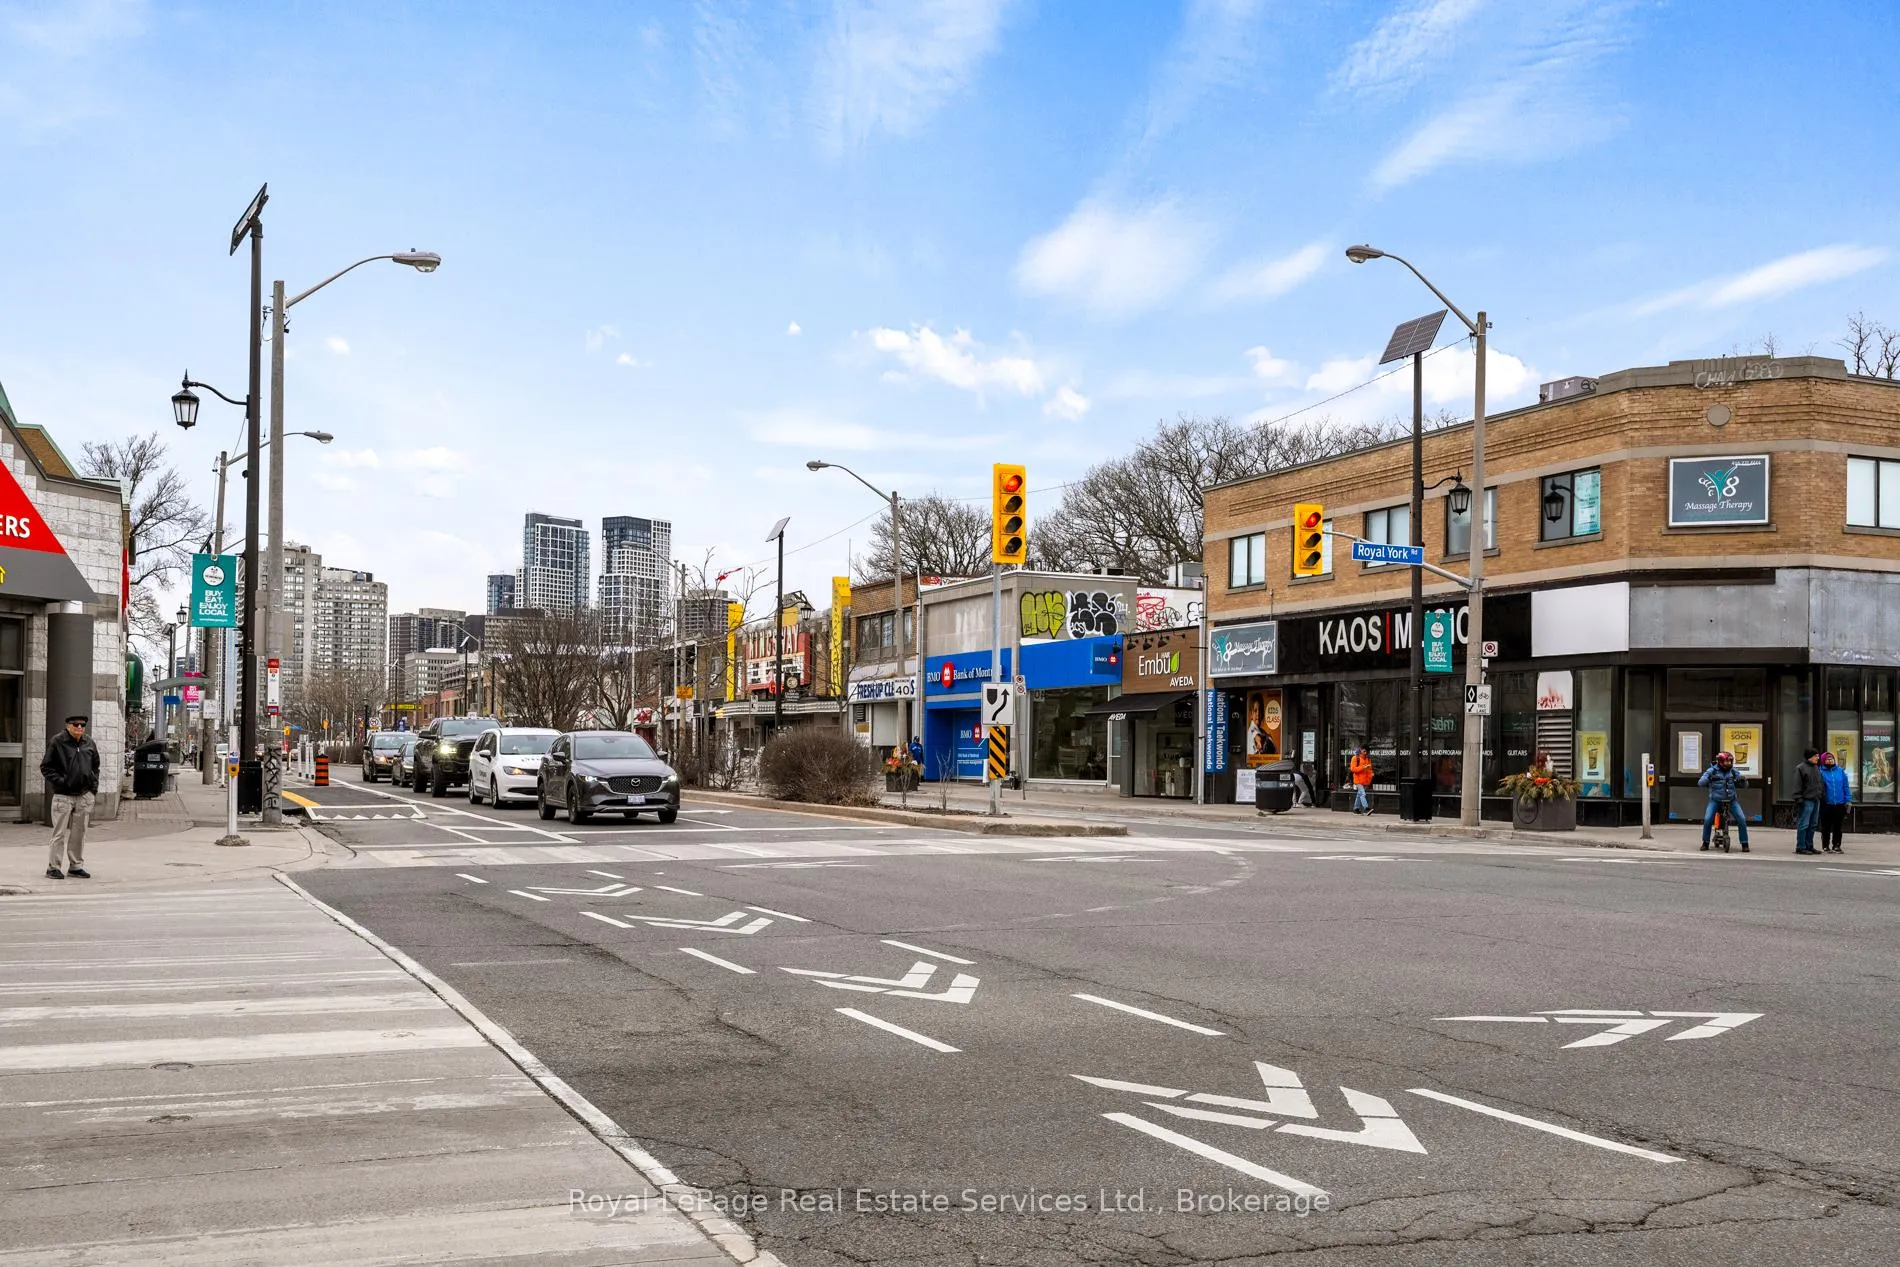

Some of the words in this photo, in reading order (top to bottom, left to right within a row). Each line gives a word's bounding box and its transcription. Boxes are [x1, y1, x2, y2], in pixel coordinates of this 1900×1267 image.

[1722, 476, 1740, 497] 8
[1684, 501, 1717, 512] Massage
[1719, 499, 1753, 511] Therapy
[1358, 544, 1385, 559] Royal
[1387, 546, 1408, 559] York
[199, 602, 228, 610] ENJOY
[199, 608, 228, 617] LOCAL
[1319, 615, 1382, 655] KAOS
[1394, 605, 1469, 650] MIC
[926, 671, 941, 683] BMO
[953, 668, 968, 680] Bank
[968, 667, 975, 679] of
[975, 665, 1003, 678] Montrl
[1169, 676, 1194, 687] AVEDA
[895, 685, 910, 696] 40
[1216, 691, 1226, 724] National
[1267, 706, 1279, 714] KIDS
[1108, 712, 1127, 720] AVEDA
[960, 729, 972, 738] BMO
[1206, 726, 1214, 769] Taekwondo
[1215, 726, 1226, 770] Taekwondo
